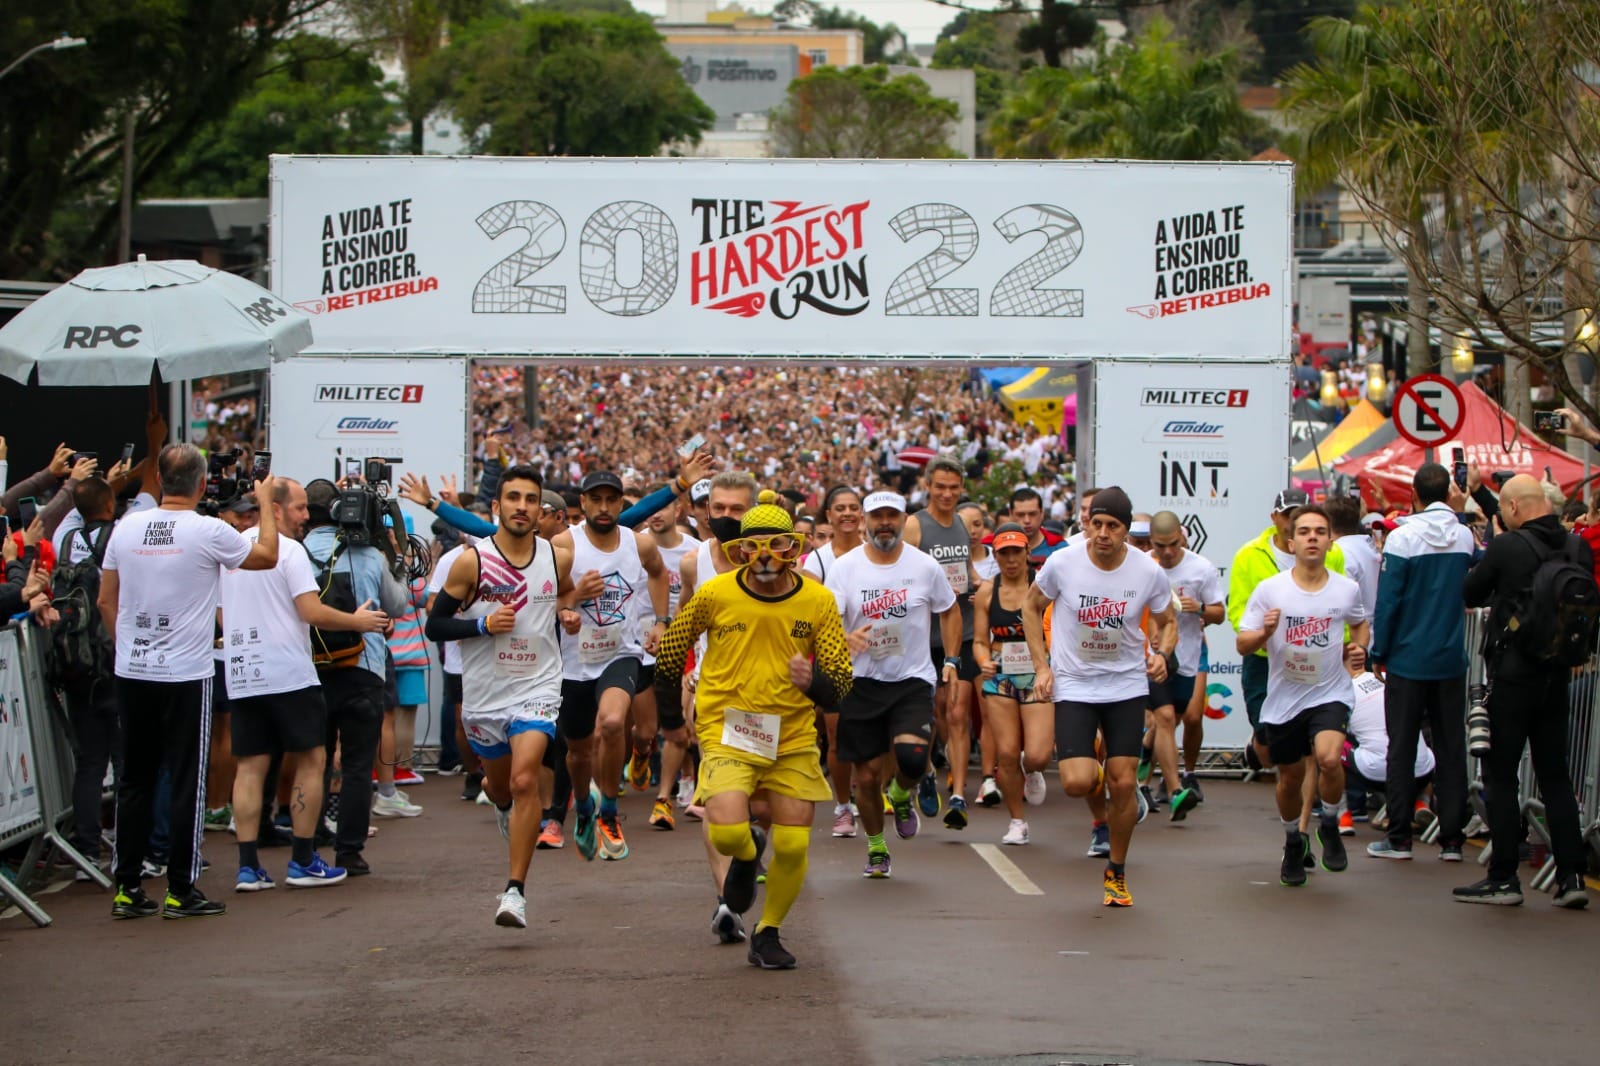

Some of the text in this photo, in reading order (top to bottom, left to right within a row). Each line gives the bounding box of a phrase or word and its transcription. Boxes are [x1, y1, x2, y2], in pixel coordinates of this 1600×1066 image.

[707, 68, 777, 81] POSITIVO
[322, 198, 412, 241] A VIDA TE
[691, 198, 765, 245] THE
[1155, 205, 1245, 245] A VIDA TE
[322, 228, 408, 267] ENSINOU
[691, 200, 870, 306] HARDEST
[1155, 233, 1240, 272] ENSINOU
[321, 253, 421, 295] A CORRER.
[1155, 259, 1253, 300] A CORRER.
[327, 277, 439, 313] RETRIBUA
[770, 254, 870, 320] RUN
[1160, 282, 1271, 318] RETRIBUA
[243, 297, 287, 327] RPC
[63, 324, 143, 349] RPC
[319, 387, 401, 400] MILITEC
[1145, 391, 1227, 405] MILITEC
[1416, 390, 1442, 431] E
[337, 417, 398, 429] Condor
[1163, 421, 1224, 433] Condor
[1171, 451, 1229, 459] INSTITUTO
[1160, 499, 1191, 507] NARA
[145, 529, 173, 537] ENSINOU
[153, 521, 168, 529] VIDA
[861, 589, 880, 602] THE
[861, 589, 908, 617] HARDEST
[1079, 594, 1099, 608] THE
[600, 601, 616, 611] ZERO
[882, 603, 907, 619] RUN
[1078, 601, 1128, 622] HARDEST
[1098, 616, 1124, 629] RUN
[1285, 617, 1332, 643] HARDEST
[1286, 616, 1305, 628] THE
[133, 638, 150, 646] RPC
[1305, 632, 1329, 648] RUN
[231, 656, 245, 664] RPC
[498, 652, 537, 661] 04.979
